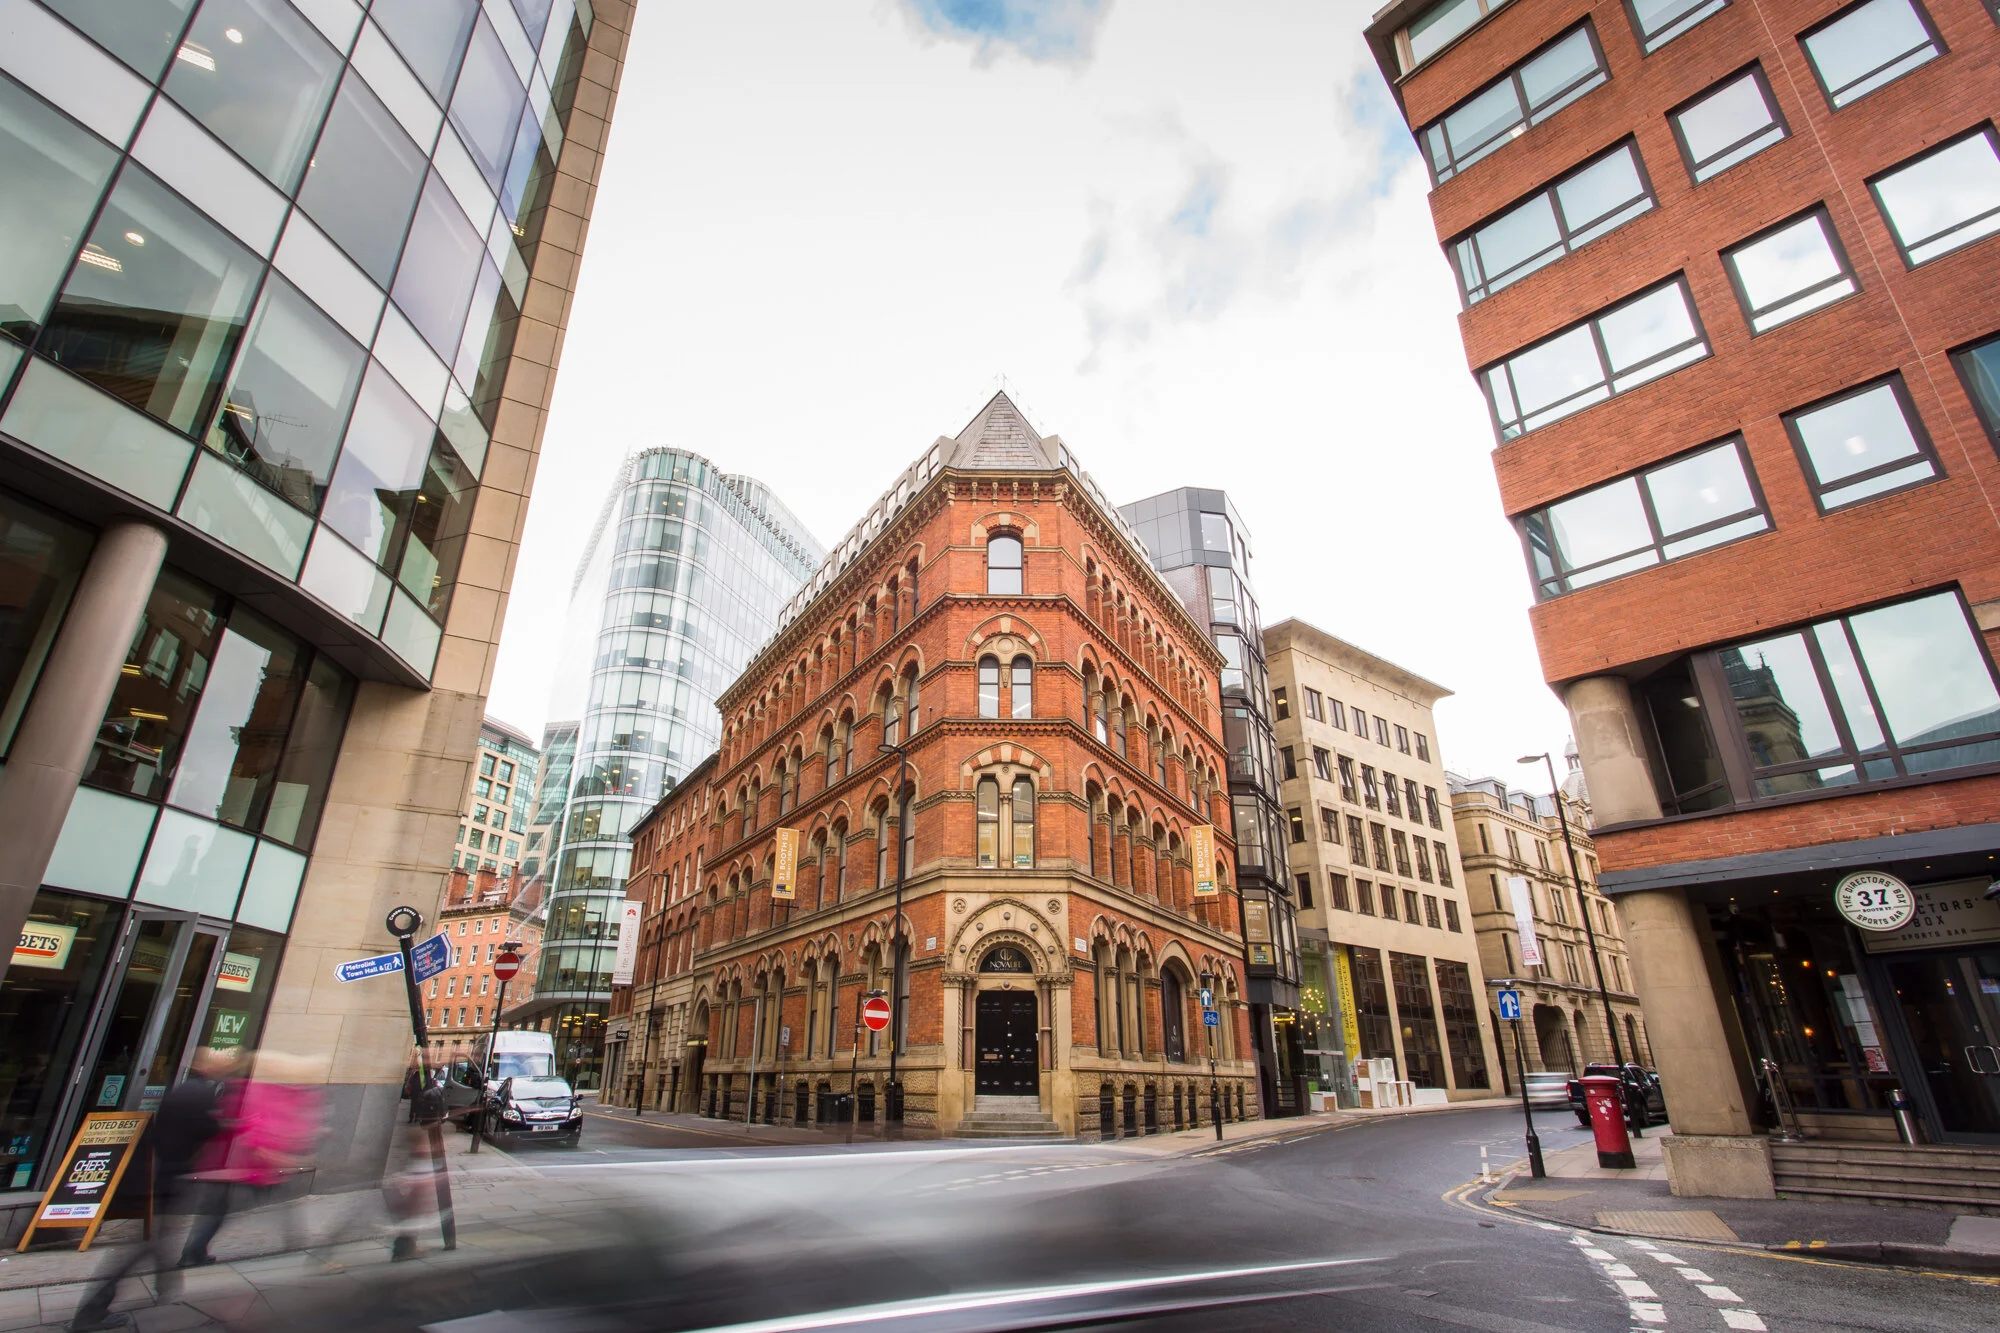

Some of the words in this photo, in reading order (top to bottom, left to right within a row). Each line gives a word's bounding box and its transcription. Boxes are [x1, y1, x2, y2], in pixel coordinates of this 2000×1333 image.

[780, 842, 788, 870] BOOTH
[1196, 840, 1204, 868] BOOTH
[1845, 876, 1894, 893] DIRECTORS'
[1843, 895, 1852, 908] THE
[1857, 889, 1888, 906] 37
[1893, 888, 1906, 904] BOX
[1917, 898, 1978, 914] CTORS'
[1857, 914, 1888, 924] SPORTS
[1890, 910, 1904, 922] BAR
[1913, 915, 1945, 928] BOX
[18, 934, 60, 950] BETS
[1902, 931, 1940, 940] SPORTS
[1947, 928, 1968, 936] BAR
[346, 960, 376, 971] Metrolink
[346, 970, 364, 978] Town
[364, 966, 378, 975] Hall
[1342, 966, 1350, 996] OFFICES
[216, 1014, 246, 1034] NEW
[89, 1122, 118, 1130] VOTED
[118, 1120, 140, 1129] BEST
[68, 1170, 111, 1182] CHOICE
